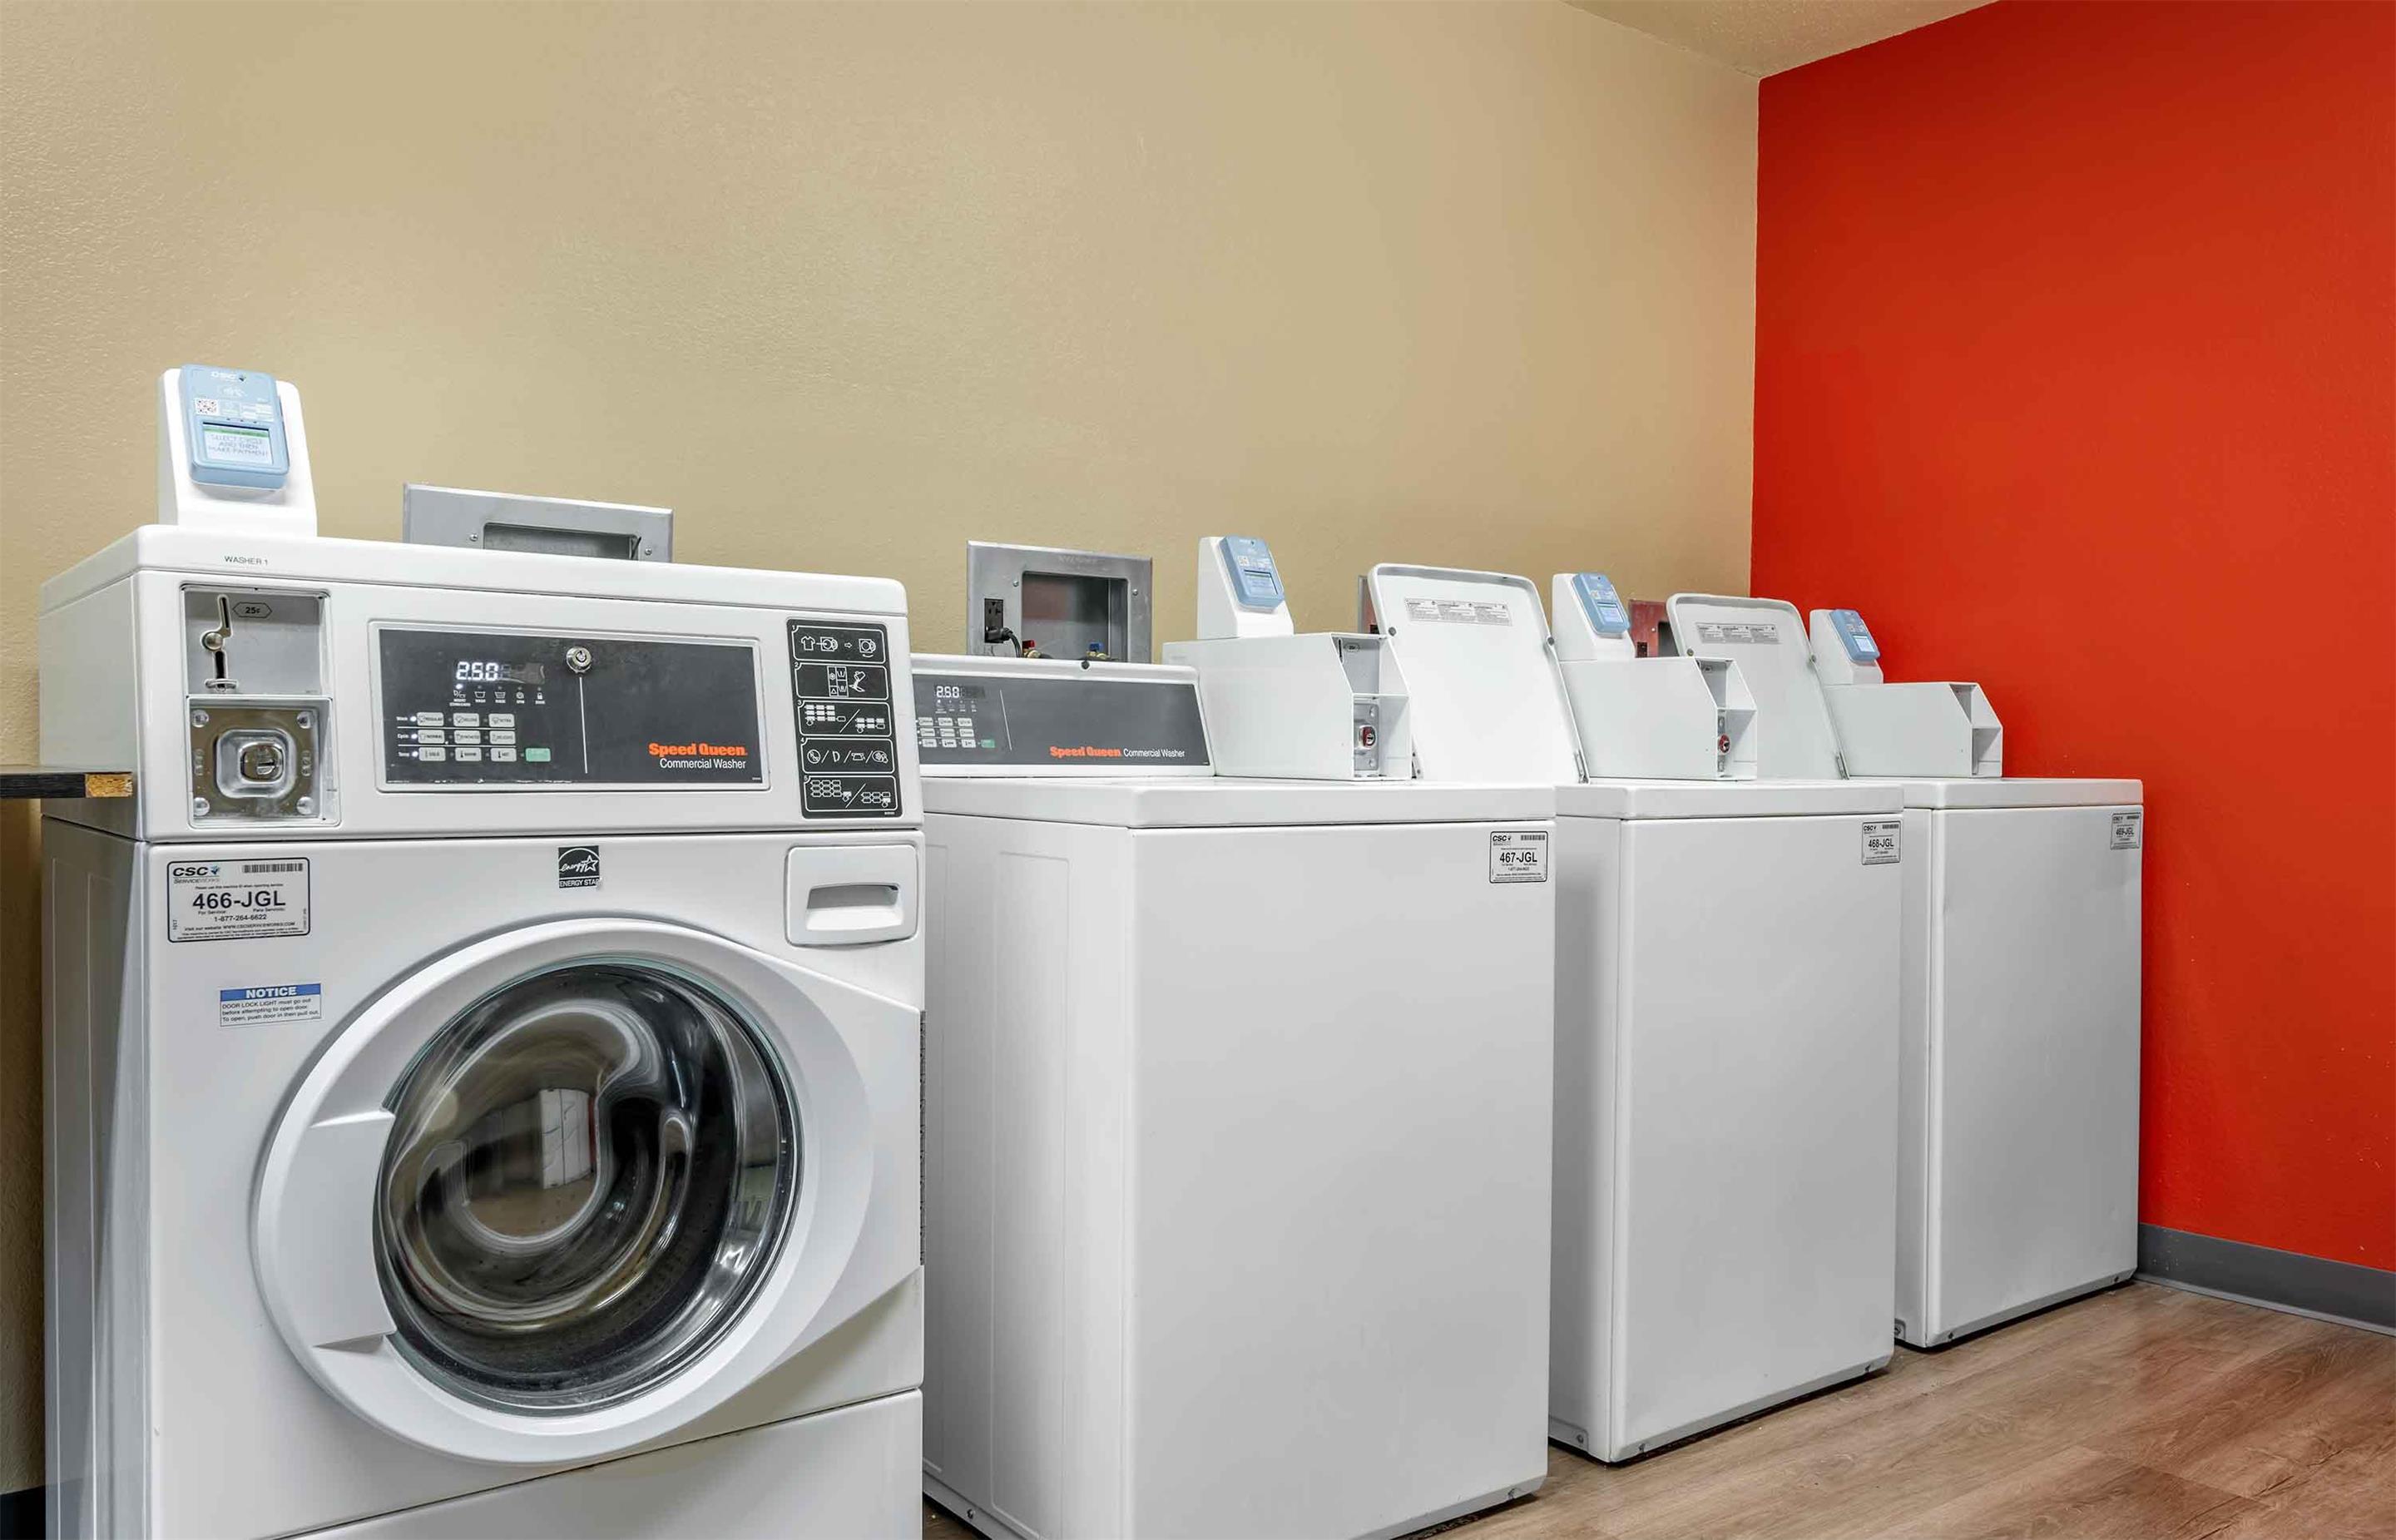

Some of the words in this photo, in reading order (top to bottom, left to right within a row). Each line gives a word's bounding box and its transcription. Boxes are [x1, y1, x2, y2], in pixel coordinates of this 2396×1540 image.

[224, 556, 261, 565] WASHER
[649, 743, 697, 757] Speed
[699, 743, 747, 755] Queen
[1050, 746, 1085, 758] Speed
[1086, 746, 1121, 756] Queen
[1123, 749, 1161, 757] Commercial
[1161, 749, 1185, 758] Washer
[660, 758, 711, 769] Commercial
[714, 759, 746, 769] Washer
[1500, 852, 1537, 863] 467-JGL
[173, 867, 208, 876] CSC
[193, 890, 286, 909] 466-JGL
[245, 987, 297, 998] NOTICE
